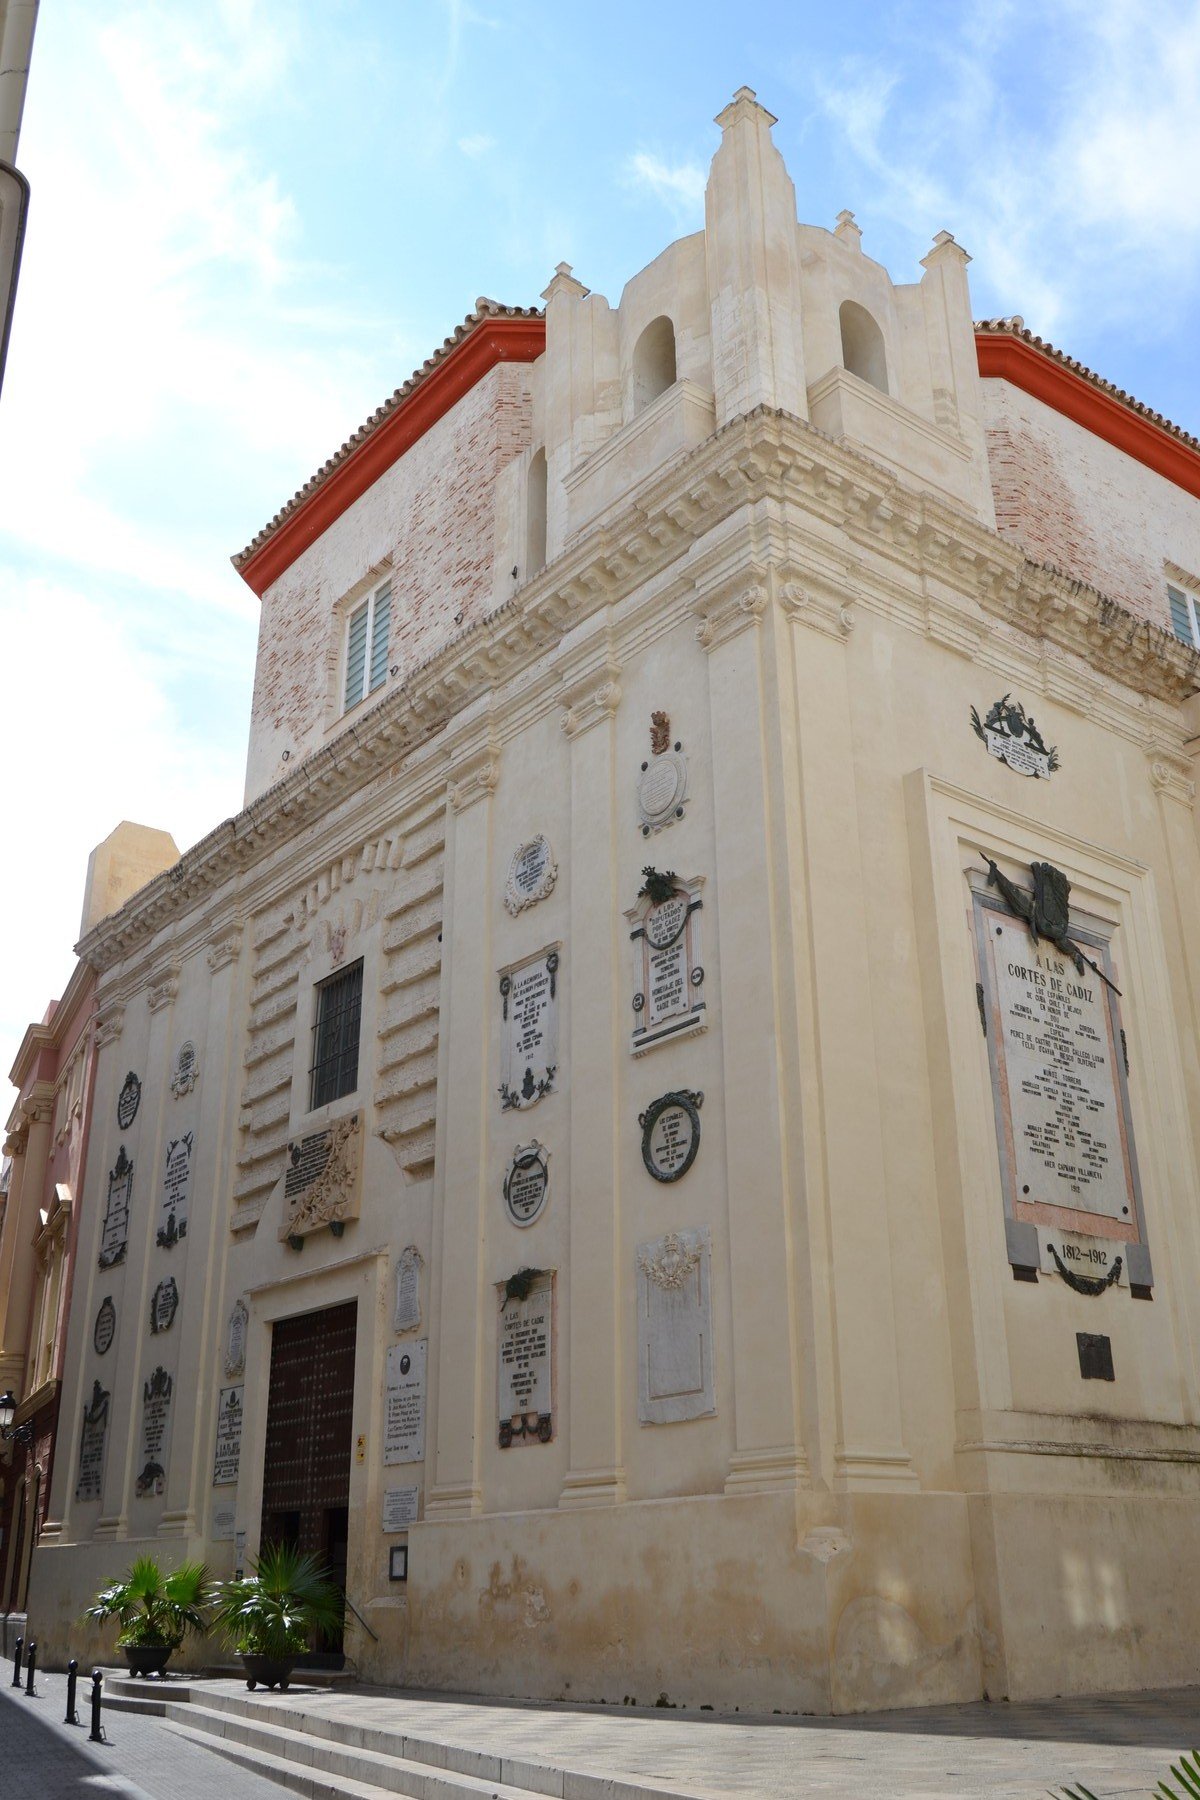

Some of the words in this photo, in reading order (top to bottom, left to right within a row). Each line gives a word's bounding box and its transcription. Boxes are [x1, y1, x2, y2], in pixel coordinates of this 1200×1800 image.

[652, 906, 681, 926] DIPUTADOS
[664, 902, 674, 912] LOS
[1037, 956, 1042, 968] A
[1046, 958, 1065, 976] LAS
[1008, 964, 1046, 987] CORTES
[1050, 978, 1062, 993] DE
[1067, 983, 1094, 1003] CADIZ
[1035, 987, 1044, 995] LOS
[1062, 1244, 1108, 1265] 1812-1912
